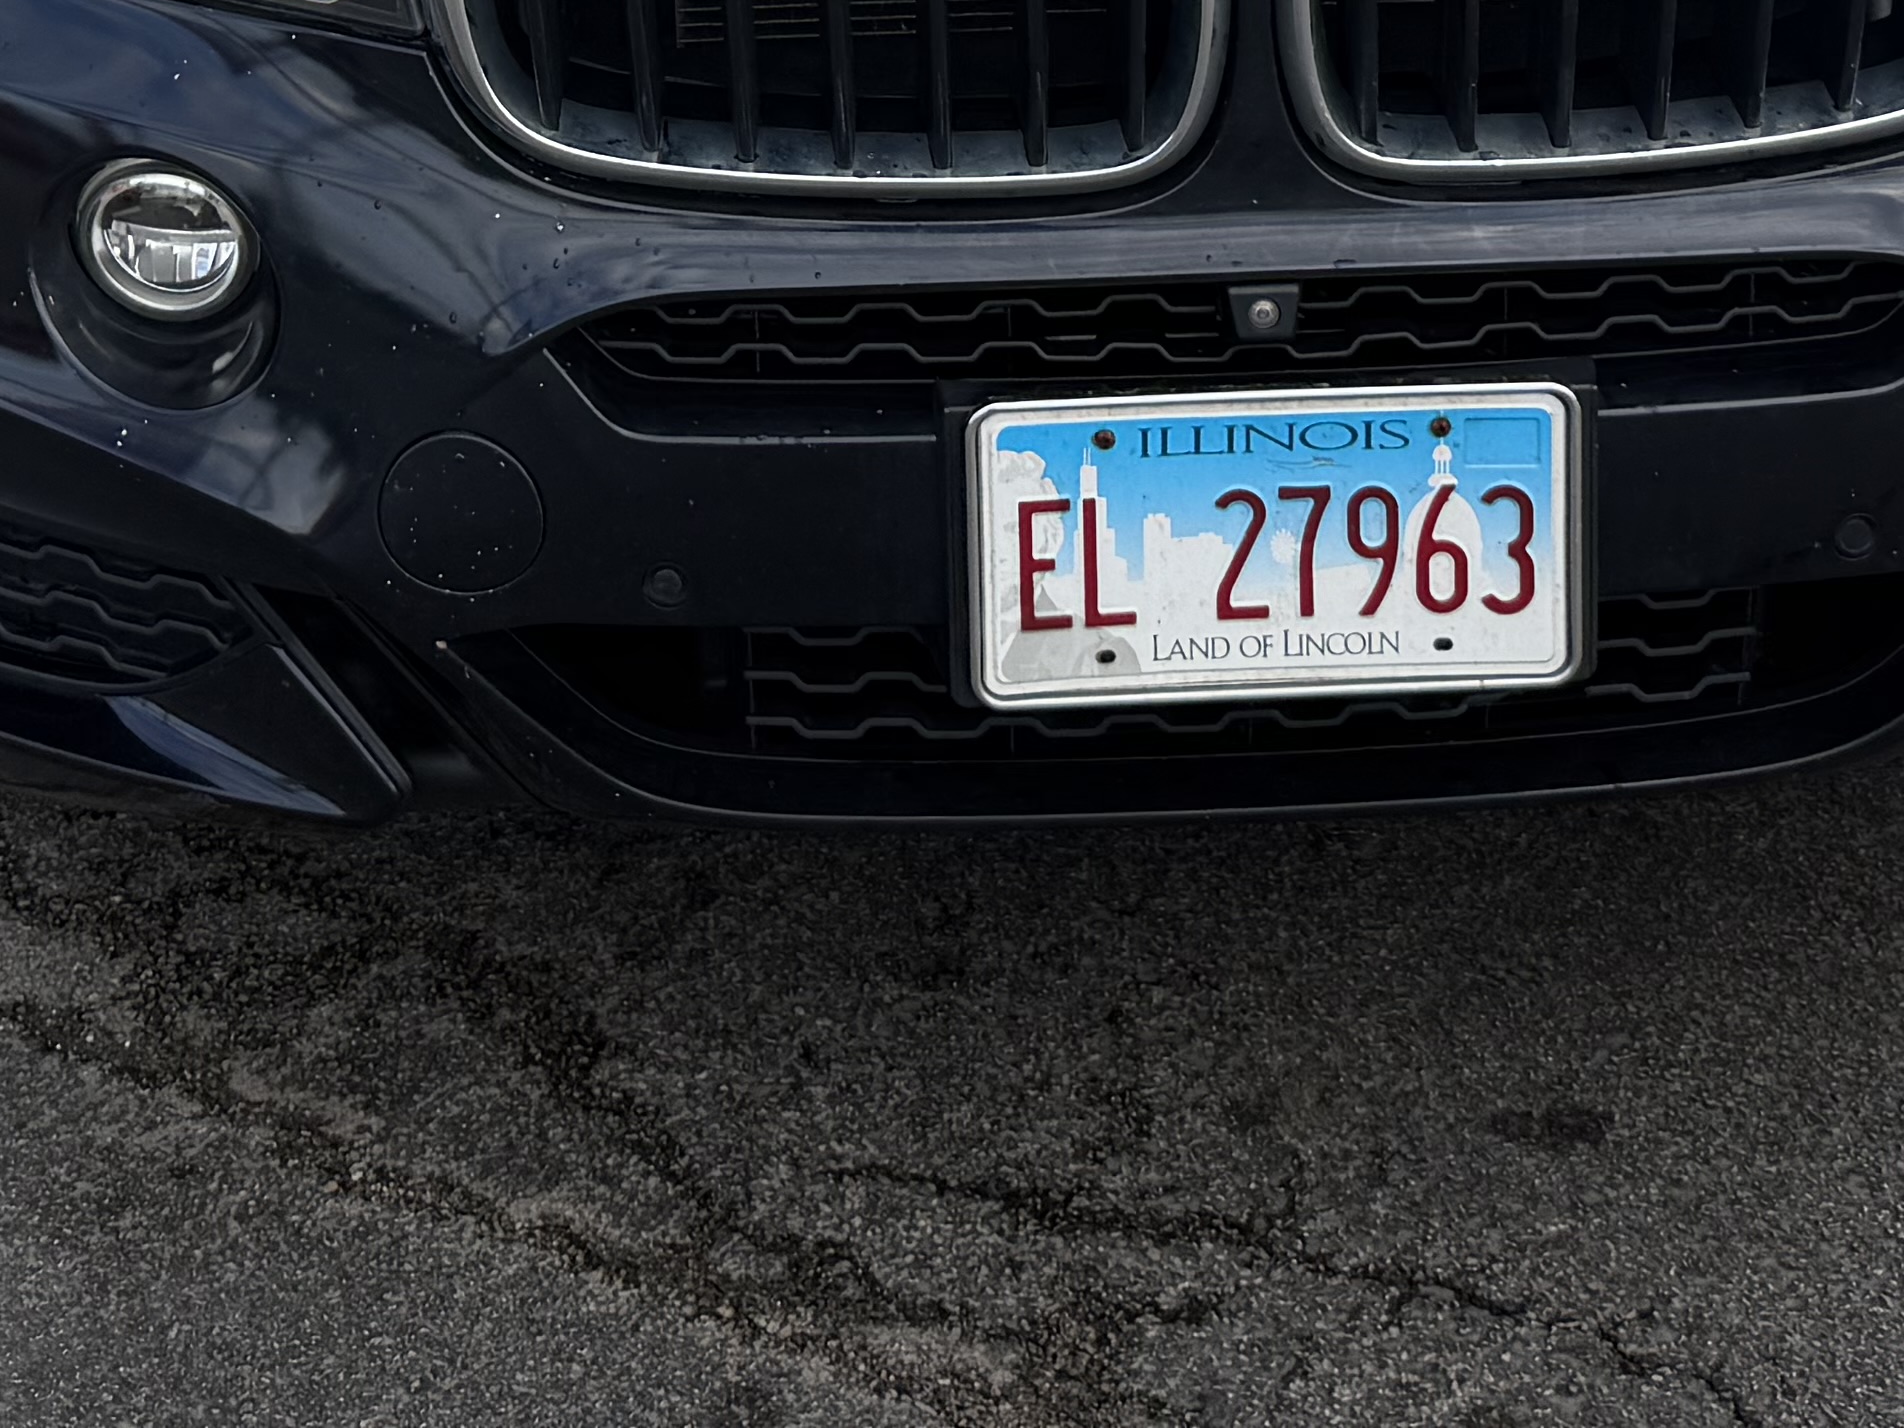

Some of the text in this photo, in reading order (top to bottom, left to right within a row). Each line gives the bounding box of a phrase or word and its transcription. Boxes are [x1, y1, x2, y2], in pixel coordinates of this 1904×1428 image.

[1138, 418, 1411, 459] ILLINOIS
[1017, 484, 1535, 631] EL 27963
